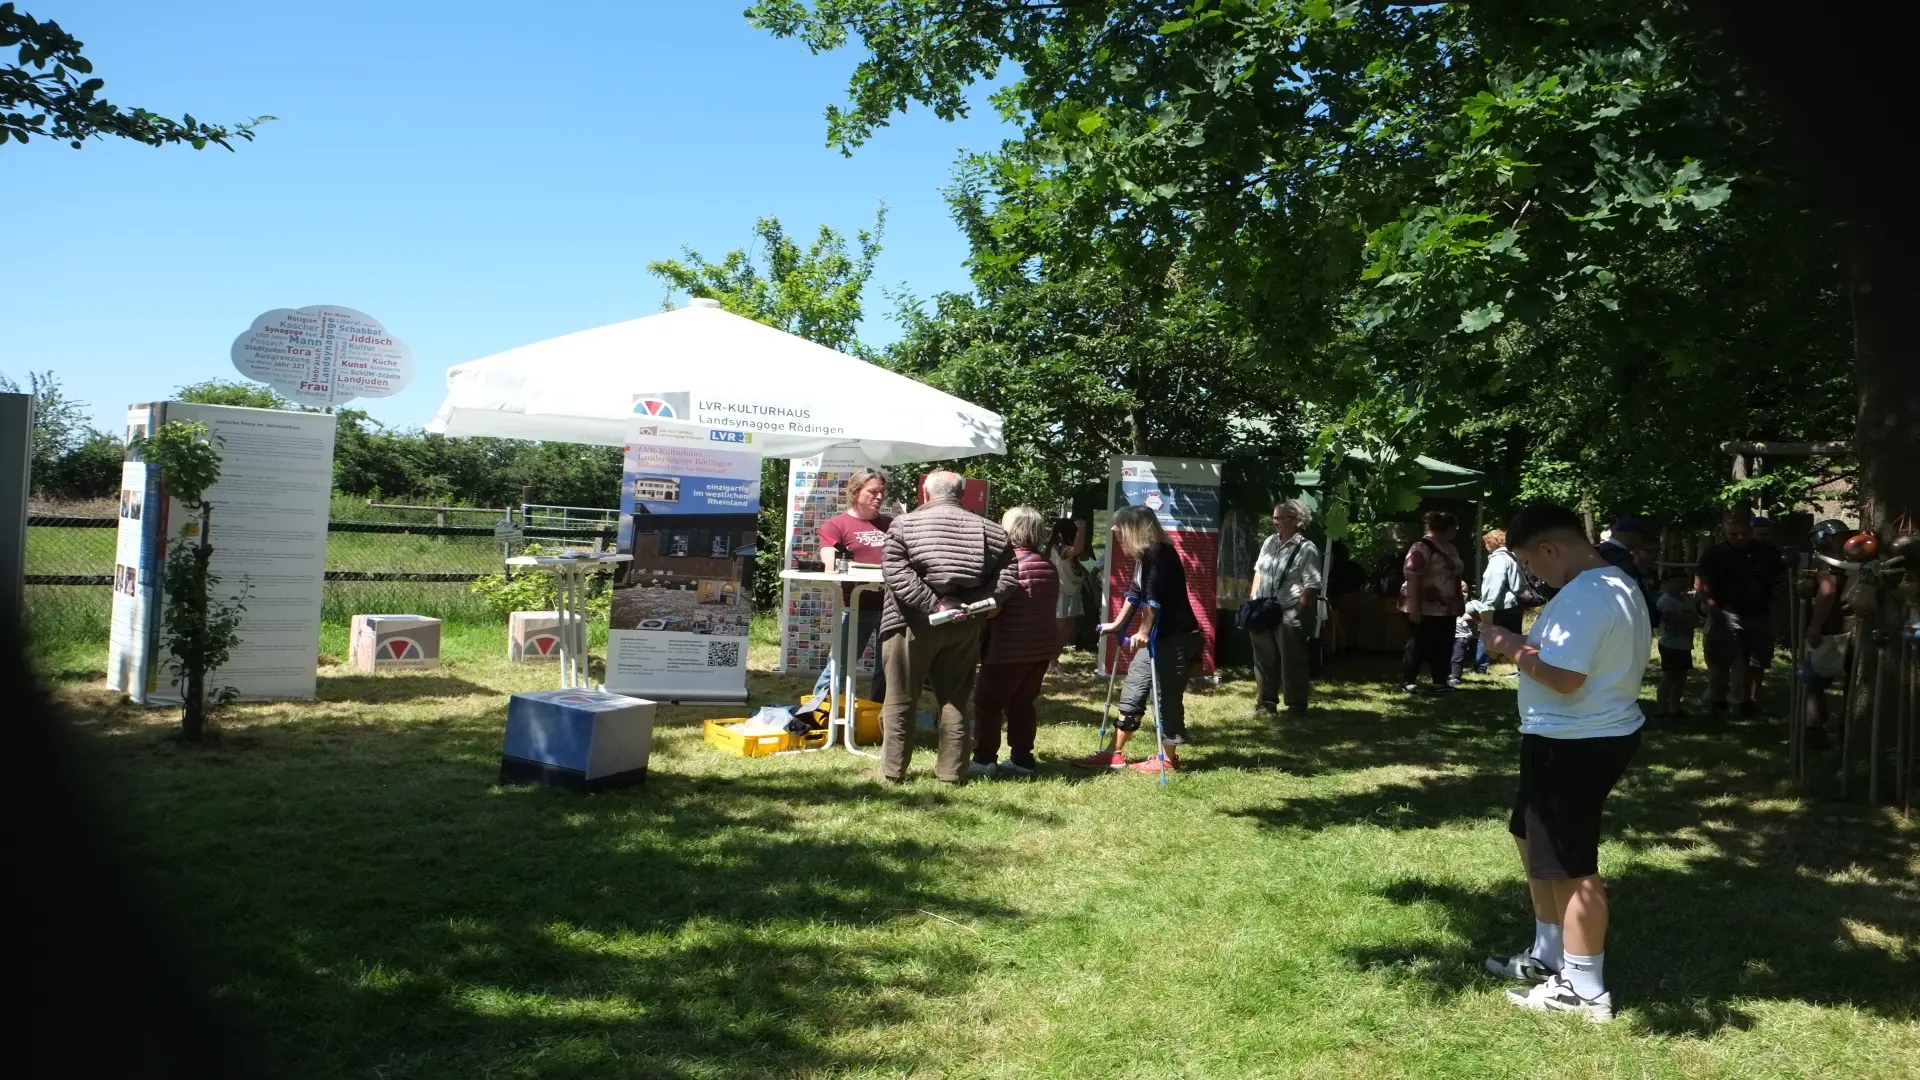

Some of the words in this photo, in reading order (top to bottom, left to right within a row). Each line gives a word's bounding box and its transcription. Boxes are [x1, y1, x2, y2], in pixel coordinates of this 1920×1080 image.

[287, 315, 318, 324] Religion
[264, 325, 303, 336] Synagoge
[280, 321, 321, 332] Koscher
[339, 325, 382, 336] Schabbat
[250, 338, 284, 346] Pessach
[289, 335, 322, 346] Mann
[348, 334, 392, 346] Jiddisch
[244, 345, 286, 354] Stadtjuden
[286, 345, 312, 356] Tora
[320, 317, 336, 384] Landsynagoge
[348, 343, 376, 351] Kultur
[254, 352, 311, 364] Ausgrenzung
[372, 358, 398, 367] Küche
[341, 360, 368, 369] Kunst
[337, 375, 389, 386] Landjuden
[300, 381, 328, 392] Frau
[336, 383, 364, 391] Musik
[699, 401, 811, 419] LVR-KULTURHAUS
[699, 415, 786, 431] Landsynagoge
[789, 422, 845, 435] Rödingen
[711, 430, 737, 441] LVR
[706, 483, 749, 493] einzigartig
[705, 491, 749, 499] westlichen
[707, 498, 748, 507] Rheinland
